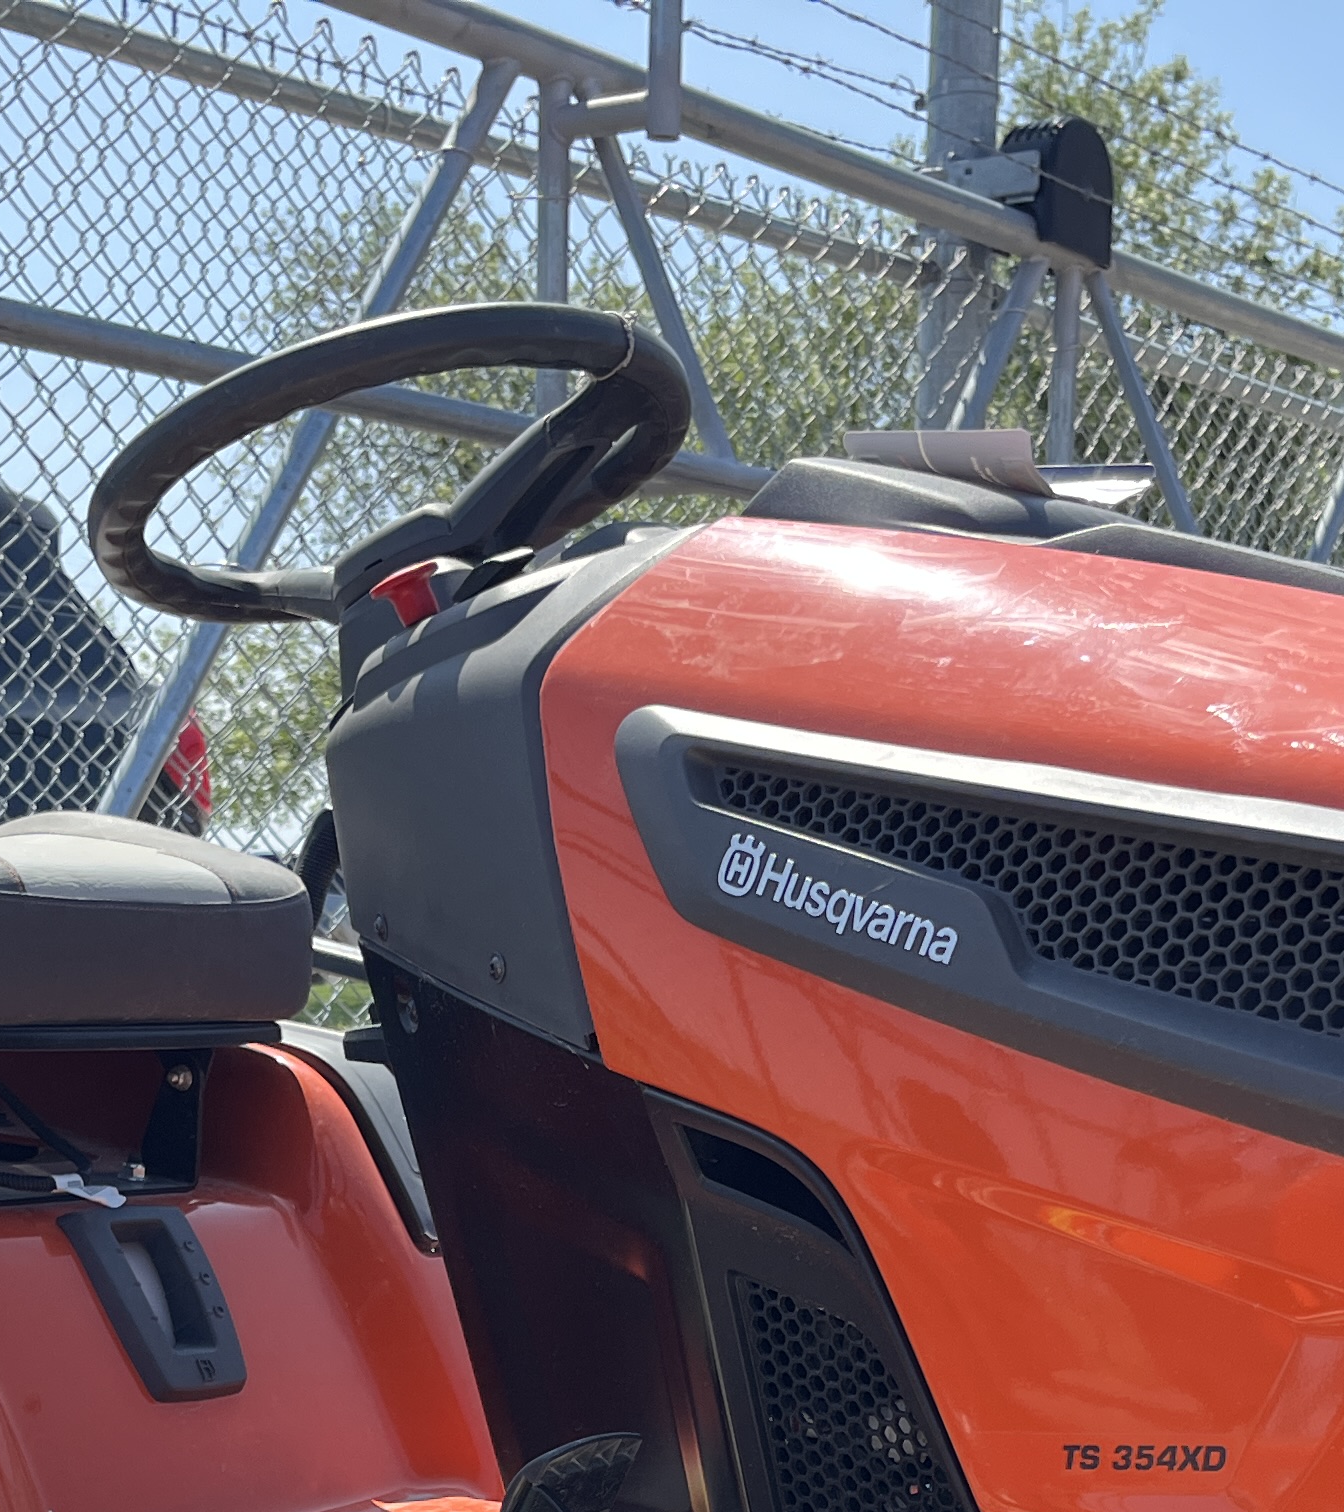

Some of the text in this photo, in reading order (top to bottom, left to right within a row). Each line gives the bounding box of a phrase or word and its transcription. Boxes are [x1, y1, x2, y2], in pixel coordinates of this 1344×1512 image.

[756, 852, 958, 966] Husqvarna
[1063, 1444, 1227, 1472] TS 354XD
